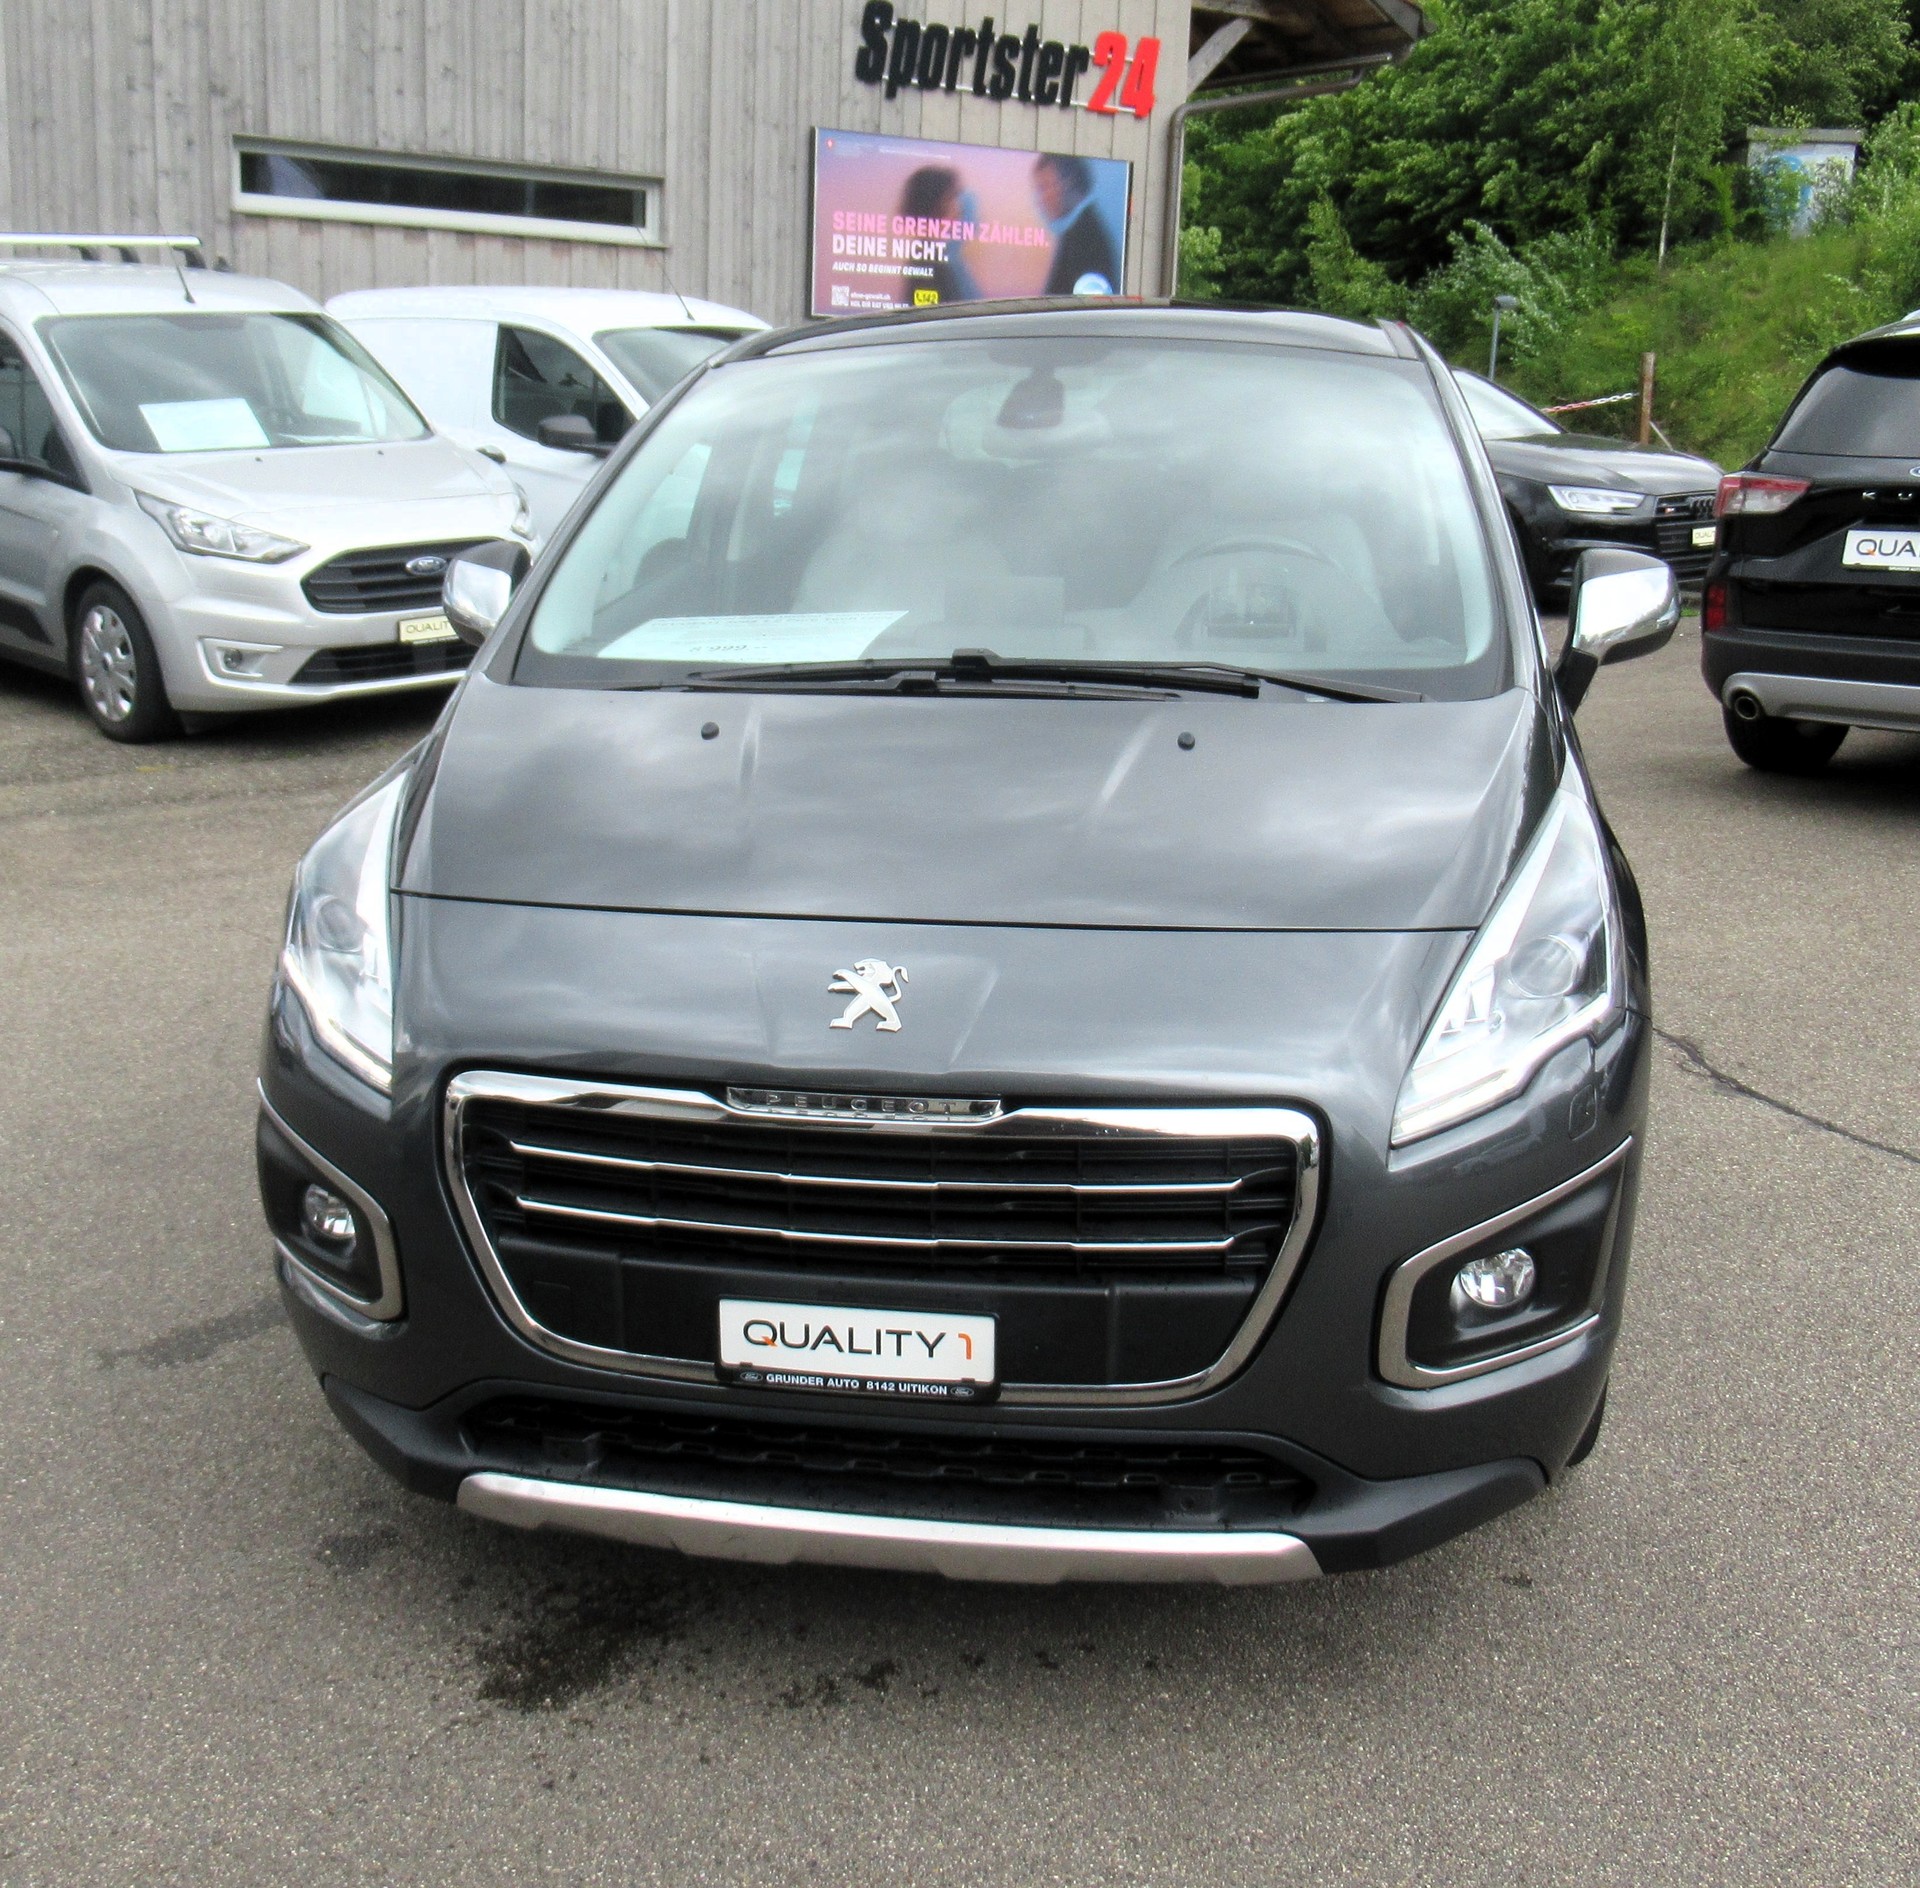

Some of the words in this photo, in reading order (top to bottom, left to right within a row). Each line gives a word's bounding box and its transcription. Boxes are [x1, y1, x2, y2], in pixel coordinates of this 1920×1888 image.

[832, 211, 887, 234] SEINE
[892, 215, 975, 241] GRENZEN
[832, 234, 887, 257] DEINE
[892, 238, 949, 262] NICHT.
[832, 261, 855, 272] AUCH
[856, 263, 867, 272] SO
[868, 264, 902, 275] BEGINNT
[1856, 539, 1920, 557] QUA
[765, 1094, 957, 1115] PEUGEOT
[743, 1319, 946, 1358] QUALITY
[958, 1333, 972, 1360] 1
[766, 1373, 824, 1386] GRUNDER
[827, 1378, 860, 1389] AUTO
[866, 1380, 895, 1391] 8142
[898, 1382, 947, 1395] UITIKON
